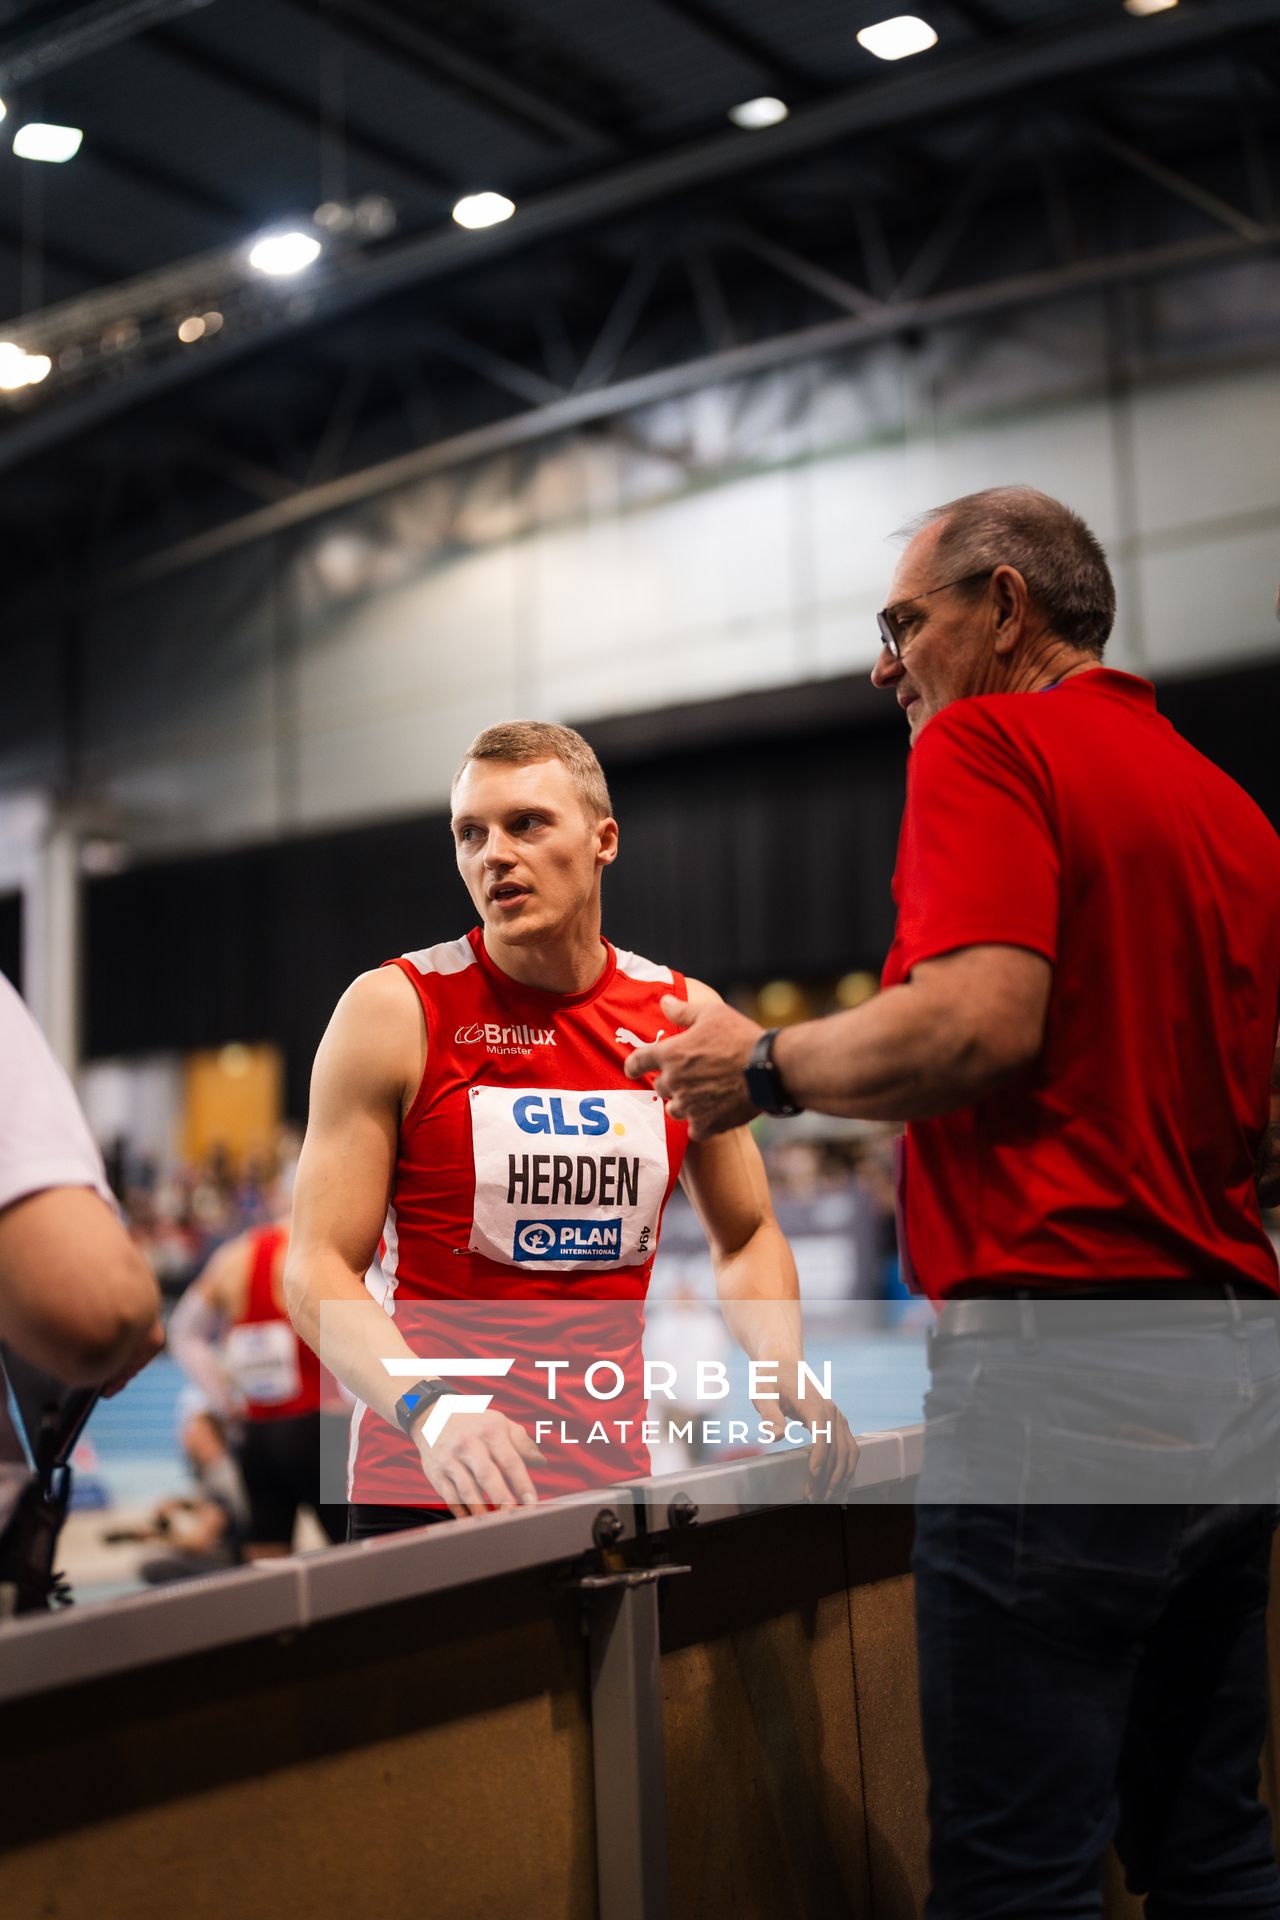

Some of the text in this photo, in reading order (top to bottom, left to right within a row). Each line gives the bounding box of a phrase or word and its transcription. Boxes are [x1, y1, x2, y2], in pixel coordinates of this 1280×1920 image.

[484, 1023, 557, 1046] Brillux
[486, 1045, 533, 1055] Münster
[506, 1154, 640, 1207] HERDEN
[560, 1227, 618, 1246] PLAN
[638, 1226, 651, 1253] 494
[560, 1248, 617, 1256] INTERNATIONAL
